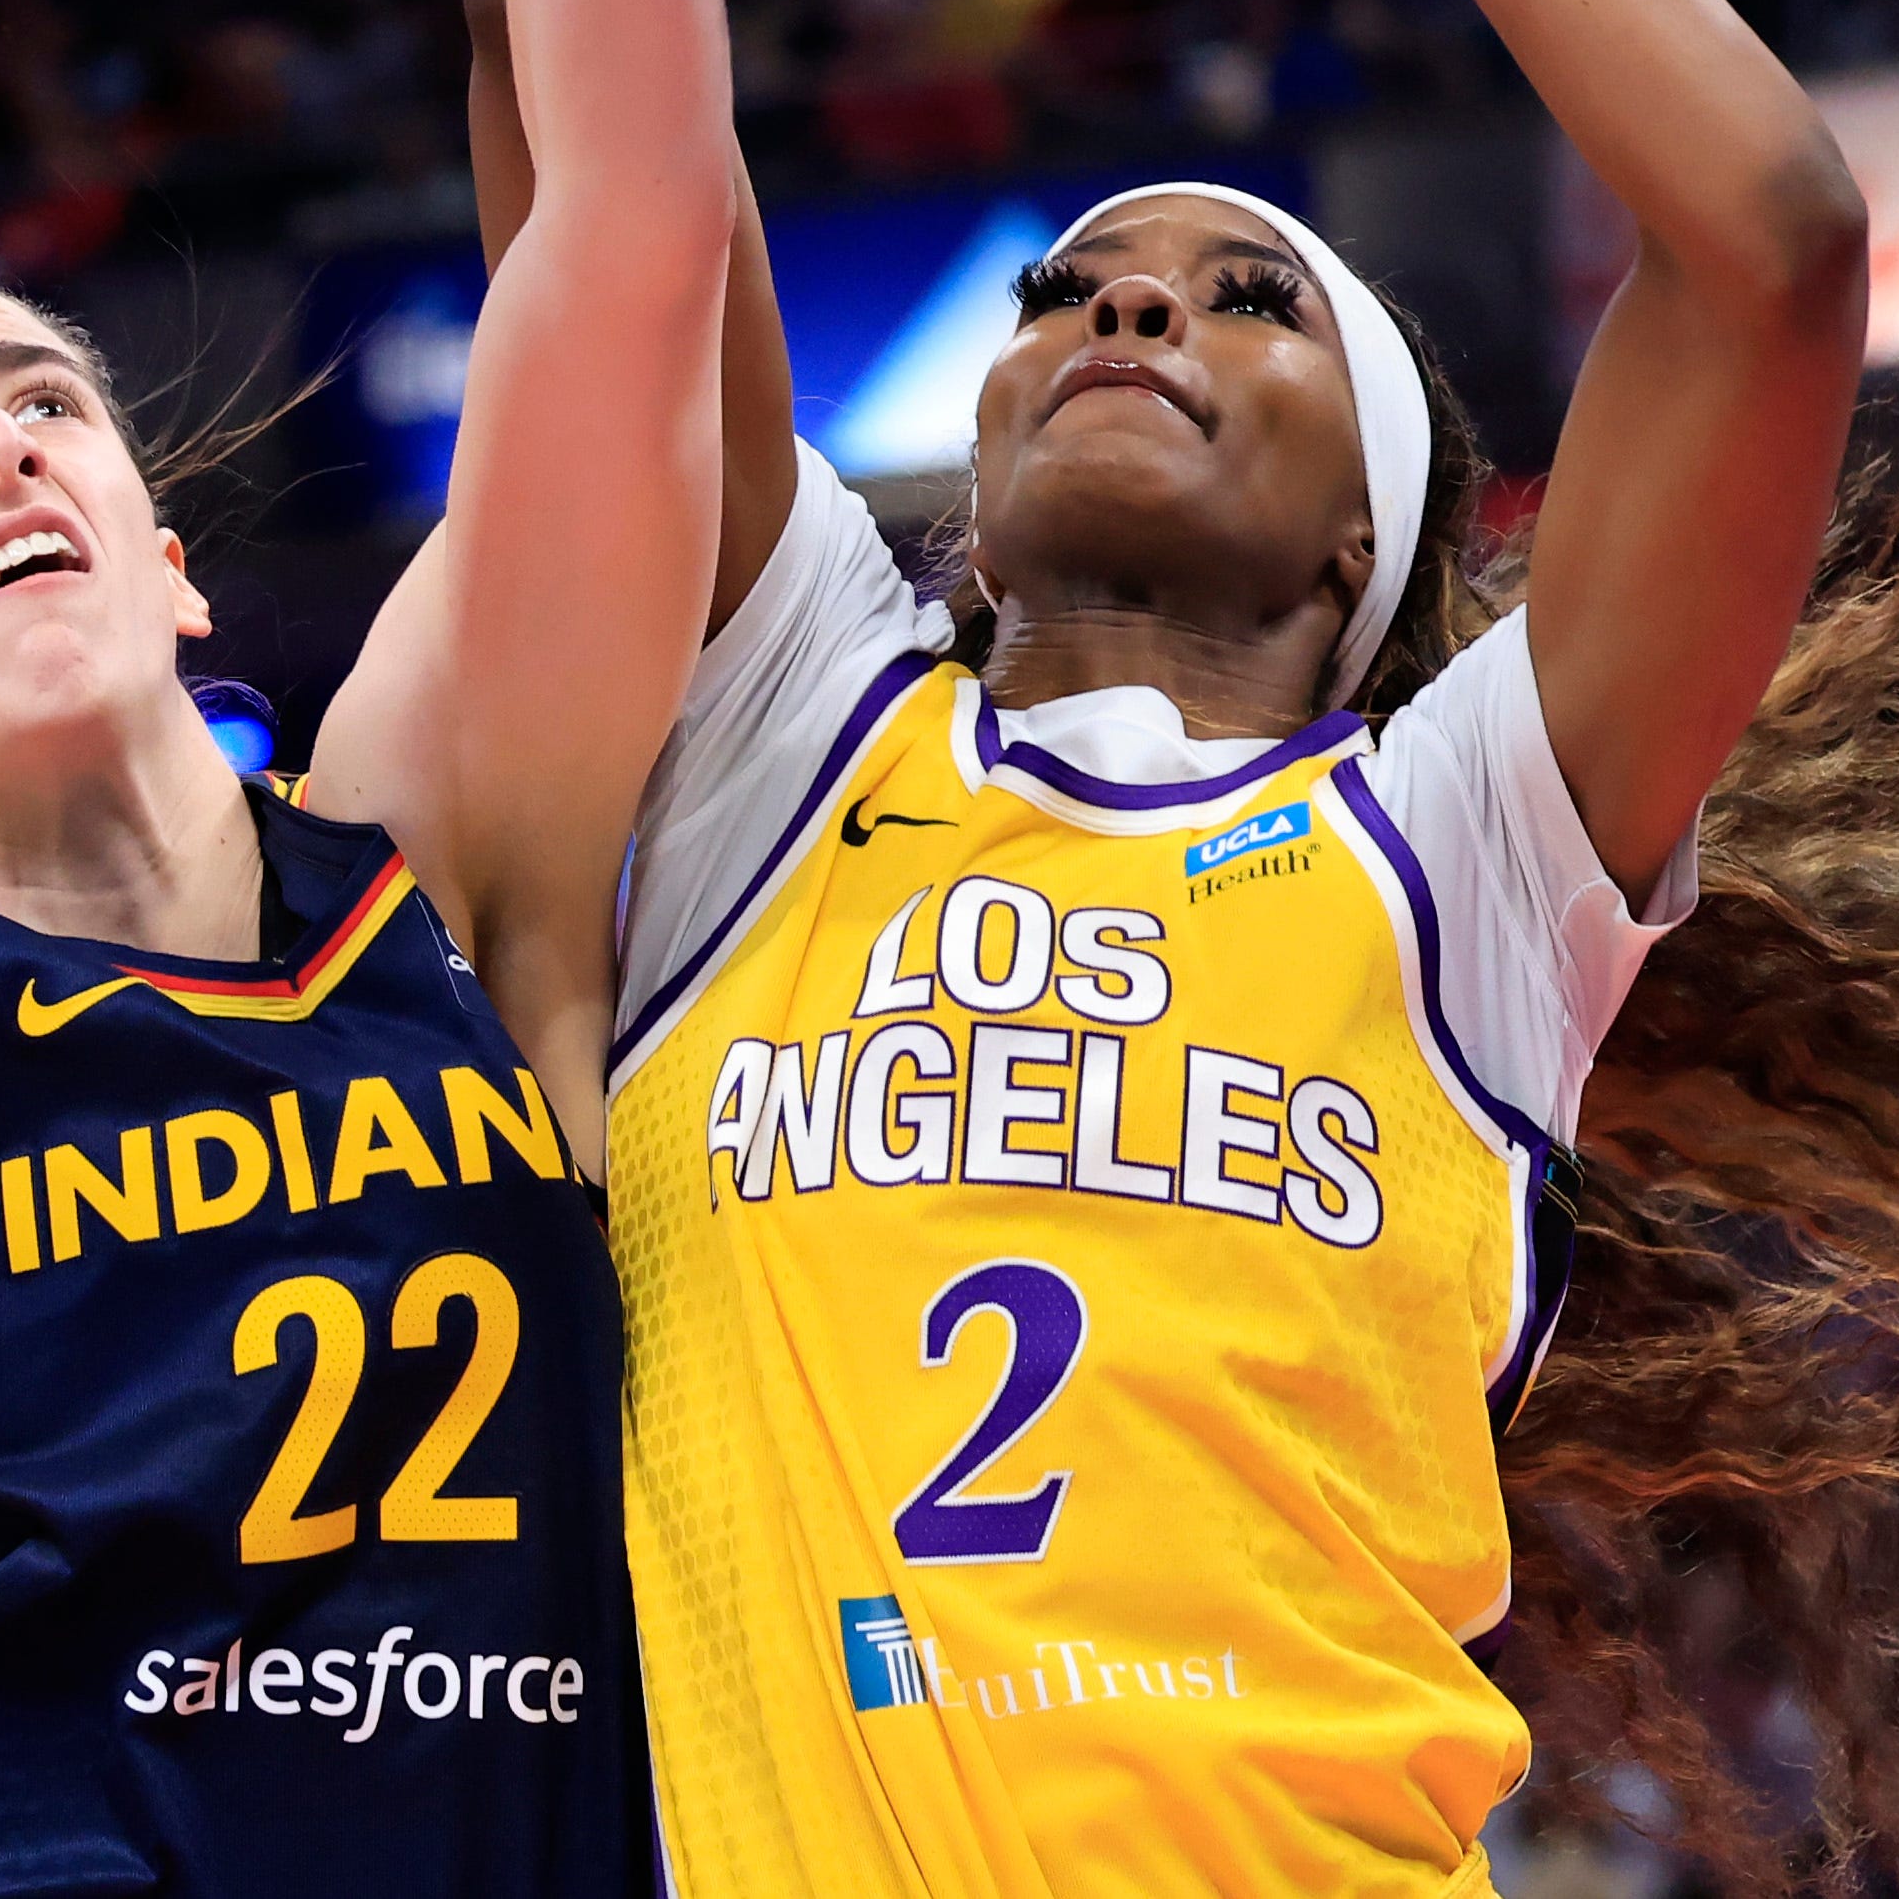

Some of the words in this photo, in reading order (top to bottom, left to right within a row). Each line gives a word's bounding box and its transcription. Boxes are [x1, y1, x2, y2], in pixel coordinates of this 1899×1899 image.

[1200, 813, 1294, 863] UCLA
[850, 875, 1172, 1025] LOS
[0, 1065, 583, 1274] INDIAN
[705, 1020, 1384, 1248] ANGELES
[232, 1252, 521, 1565] 22
[892, 1257, 1090, 1565] 2
[123, 1626, 585, 1743] salesforce
[919, 1637, 1248, 1720] EuiTrust
